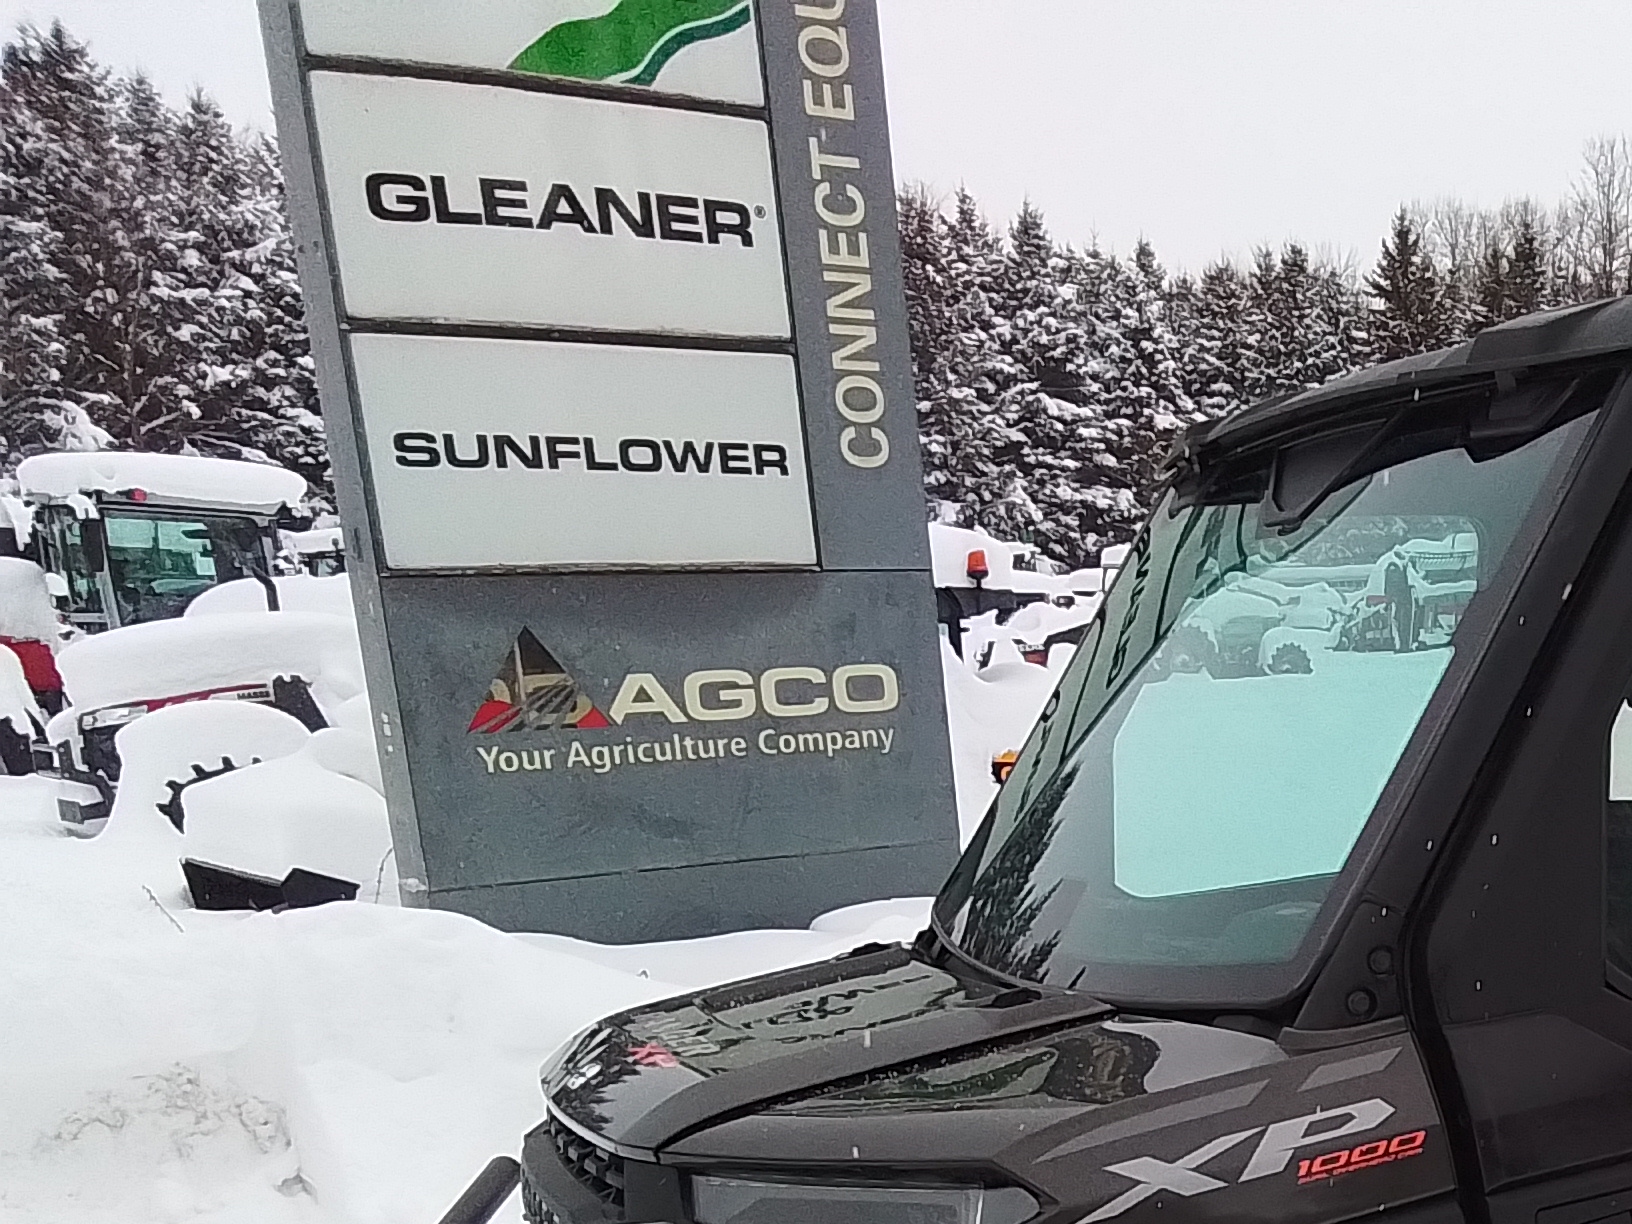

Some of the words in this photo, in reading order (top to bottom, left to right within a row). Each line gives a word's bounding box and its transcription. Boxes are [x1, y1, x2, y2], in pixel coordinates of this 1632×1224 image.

[365, 173, 754, 248] GLEANER
[808, 136, 889, 468] CONNECT
[393, 431, 789, 477] SUNFLOWER
[608, 663, 900, 726] AGCO
[476, 744, 555, 775] Your
[566, 734, 748, 774] Agriculture
[757, 725, 896, 757] Company
[1297, 1130, 1426, 1176] 1000
